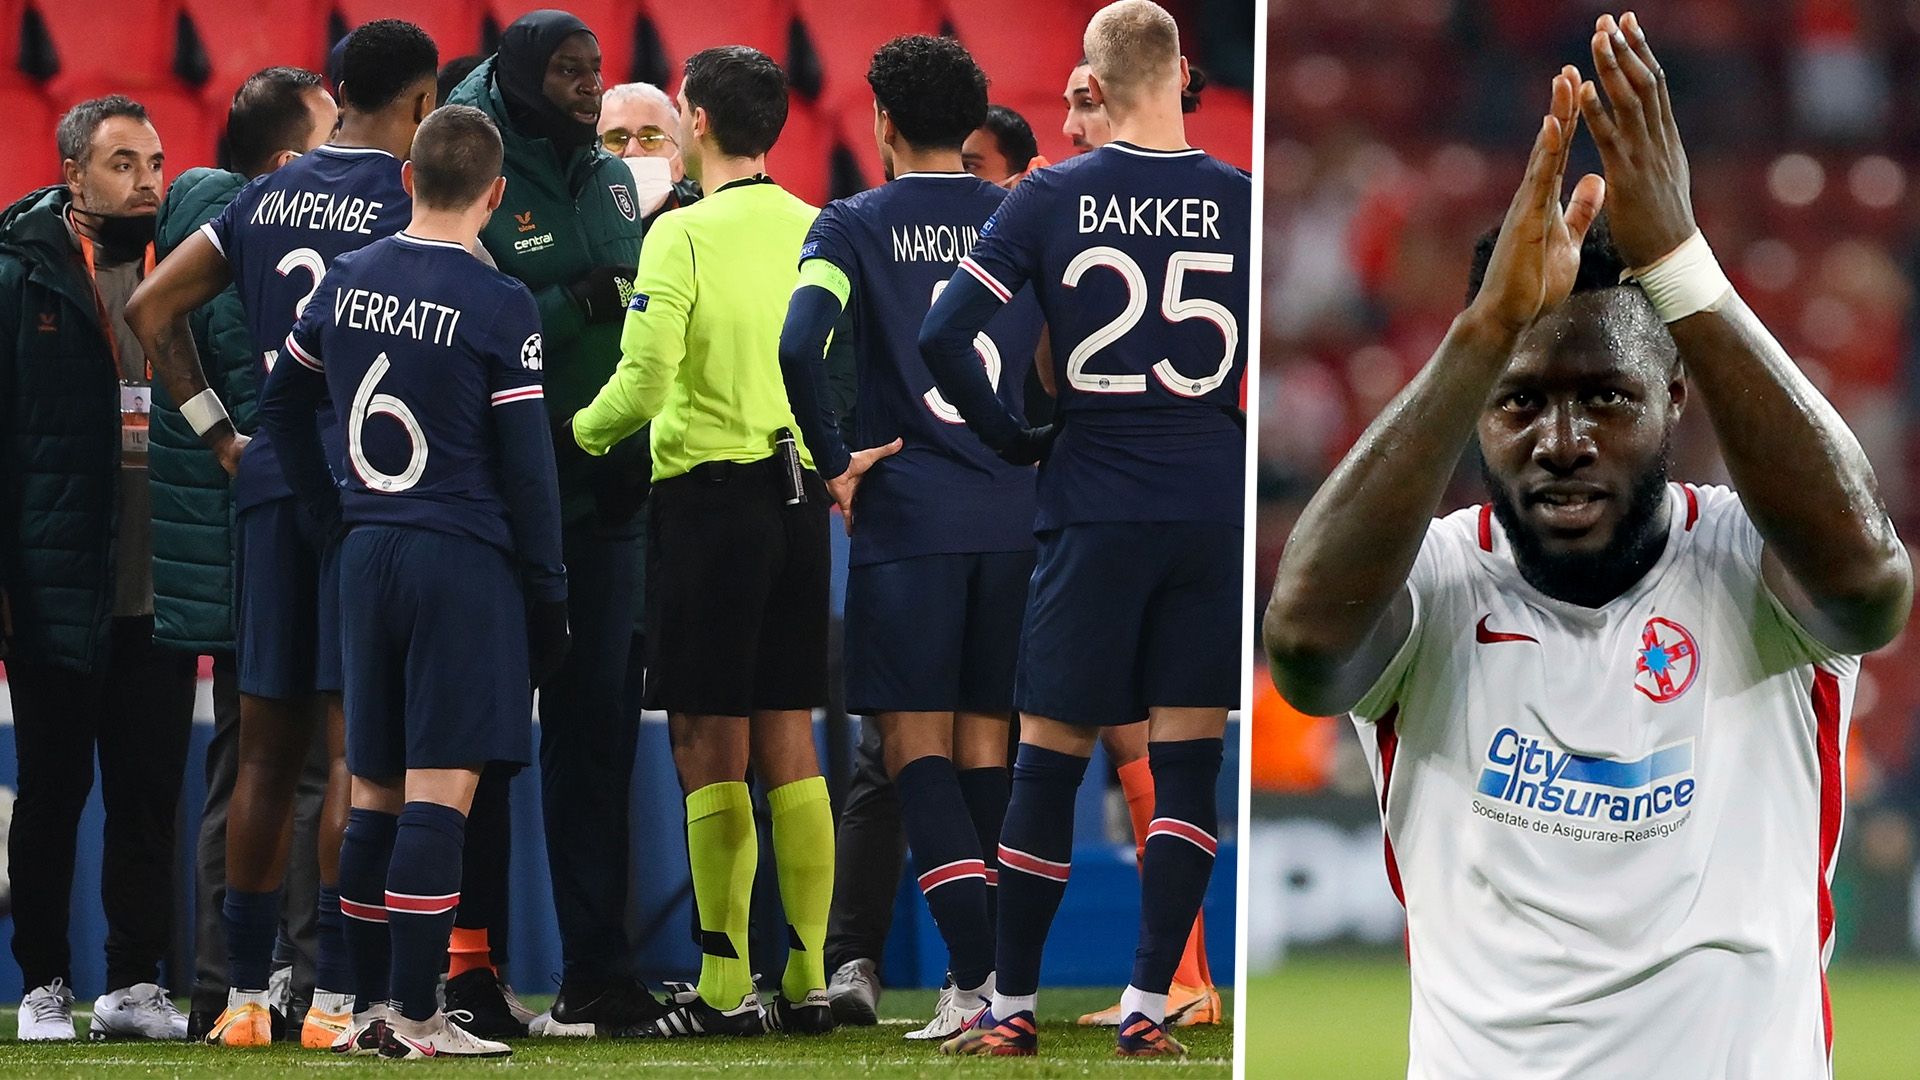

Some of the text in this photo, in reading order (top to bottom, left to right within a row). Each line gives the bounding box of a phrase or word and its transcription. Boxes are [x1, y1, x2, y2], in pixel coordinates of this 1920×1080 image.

[251, 189, 383, 234] KIMPEMBE
[1078, 193, 1221, 240] BAKKER
[514, 232, 554, 250] central
[334, 287, 461, 347] VERRATTI
[1061, 246, 1239, 398] 25
[349, 351, 429, 493] 6
[1487, 727, 1572, 787] City
[1471, 800, 1529, 829] Societate
[1532, 818, 1549, 834] de
[1503, 774, 1696, 822] Insurance
